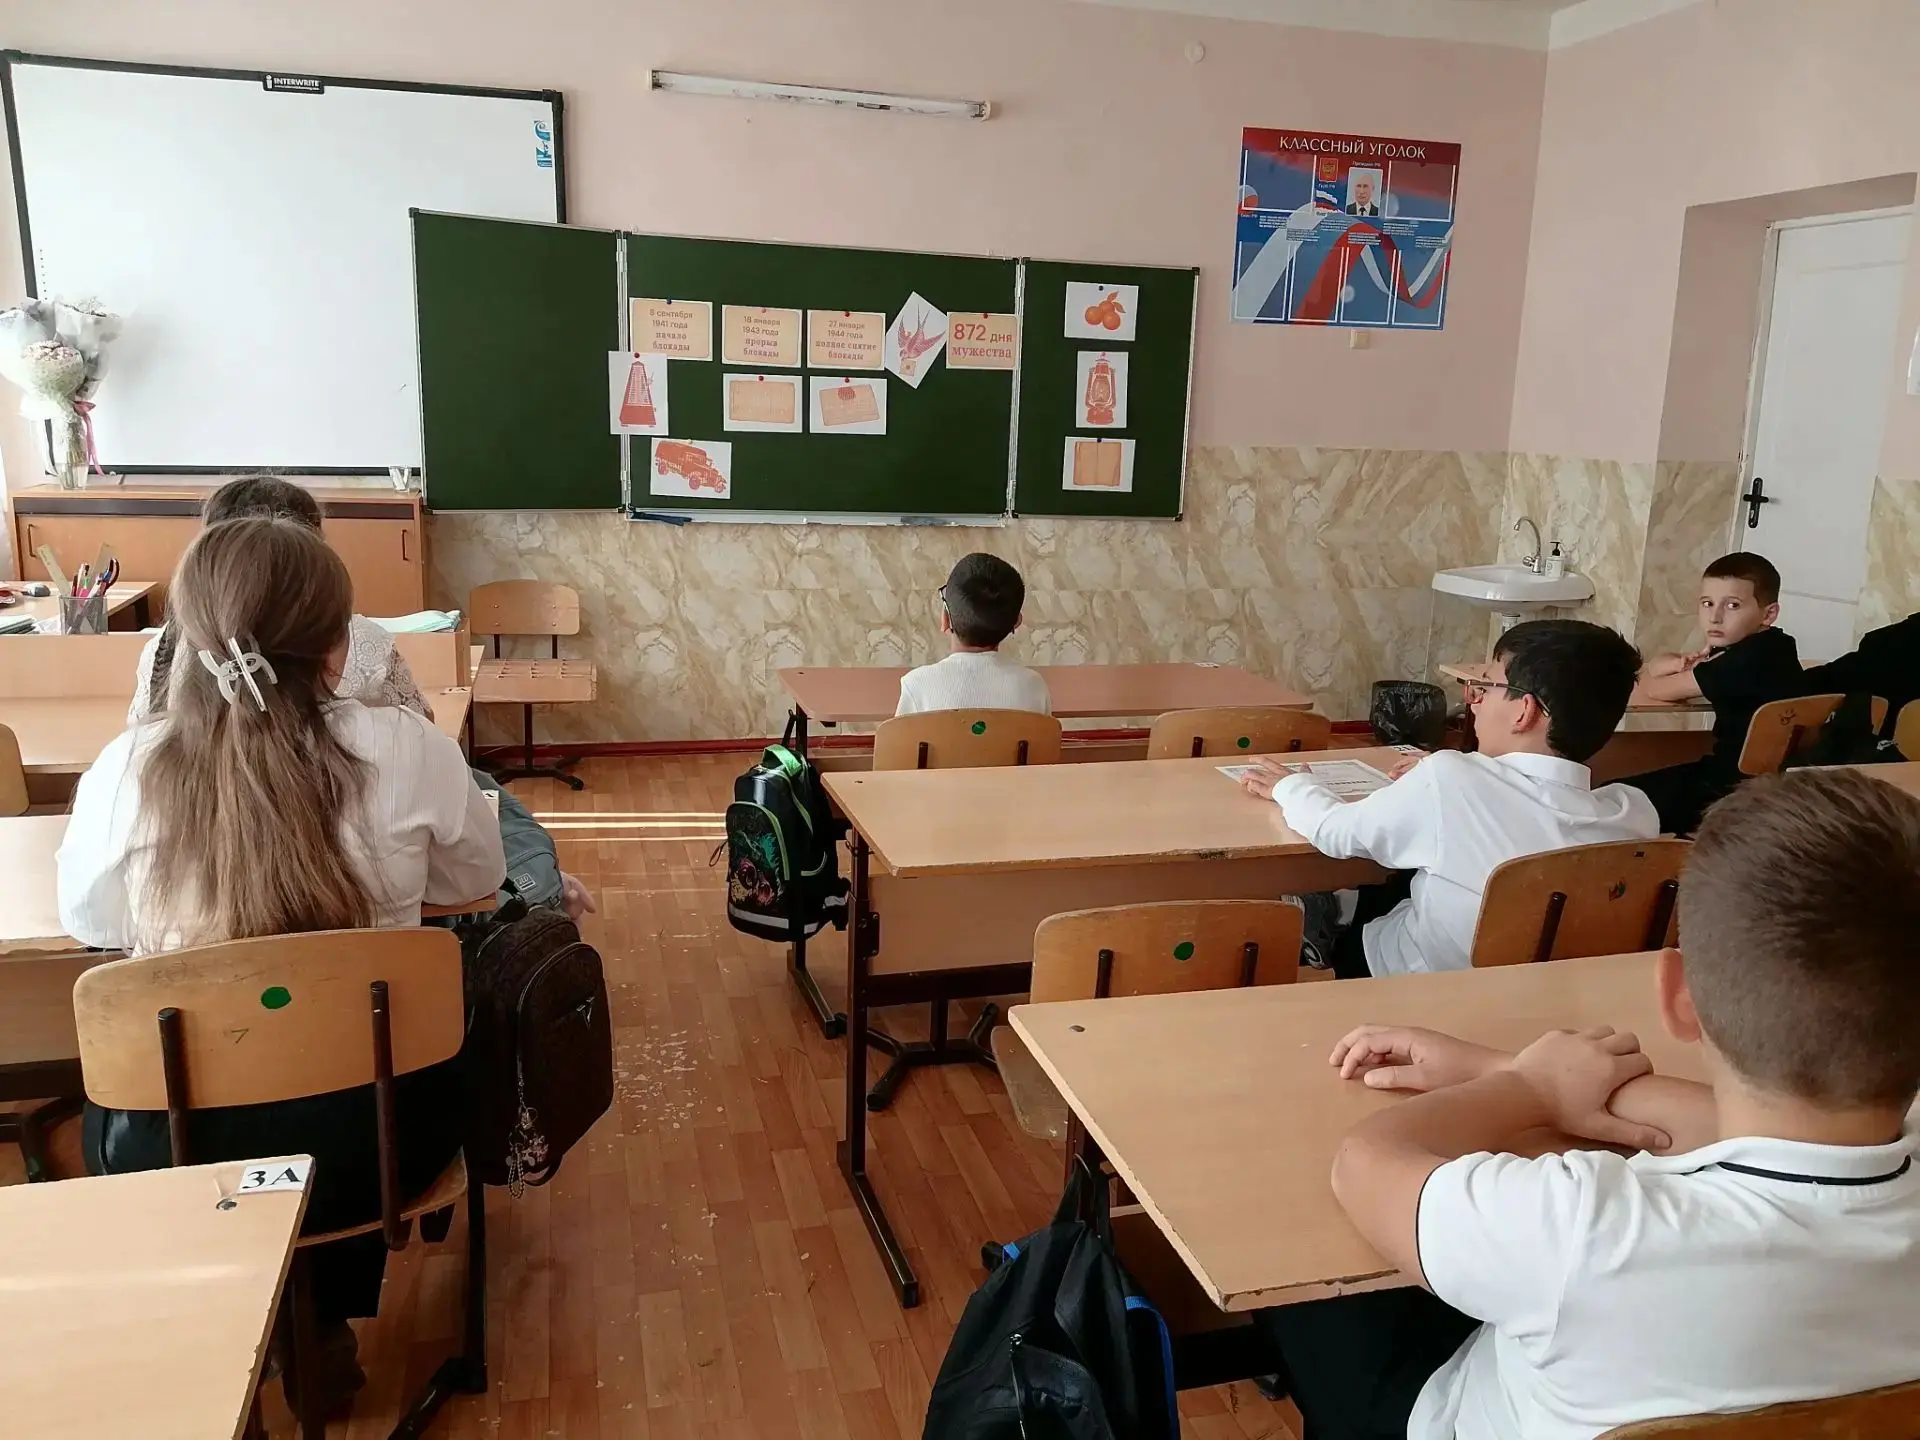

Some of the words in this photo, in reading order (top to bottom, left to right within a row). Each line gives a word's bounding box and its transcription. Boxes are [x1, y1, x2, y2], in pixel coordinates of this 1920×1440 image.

[273, 77, 321, 87] INTERWRITE
[1279, 136, 1364, 155] КЛАССНЫЙ
[1369, 143, 1426, 159] УГОЛОК
[656, 310, 693, 319] сентября
[652, 319, 669, 327] 1941
[670, 321, 688, 329] года
[753, 318, 781, 326] января
[742, 326, 760, 334] 1943
[828, 329, 845, 337] 1944
[953, 322, 987, 341] 872
[989, 333, 1013, 343] дня
[652, 341, 690, 351] блокады
[743, 347, 779, 357] блокады
[828, 351, 864, 360] блокады
[951, 346, 1012, 359] мужества
